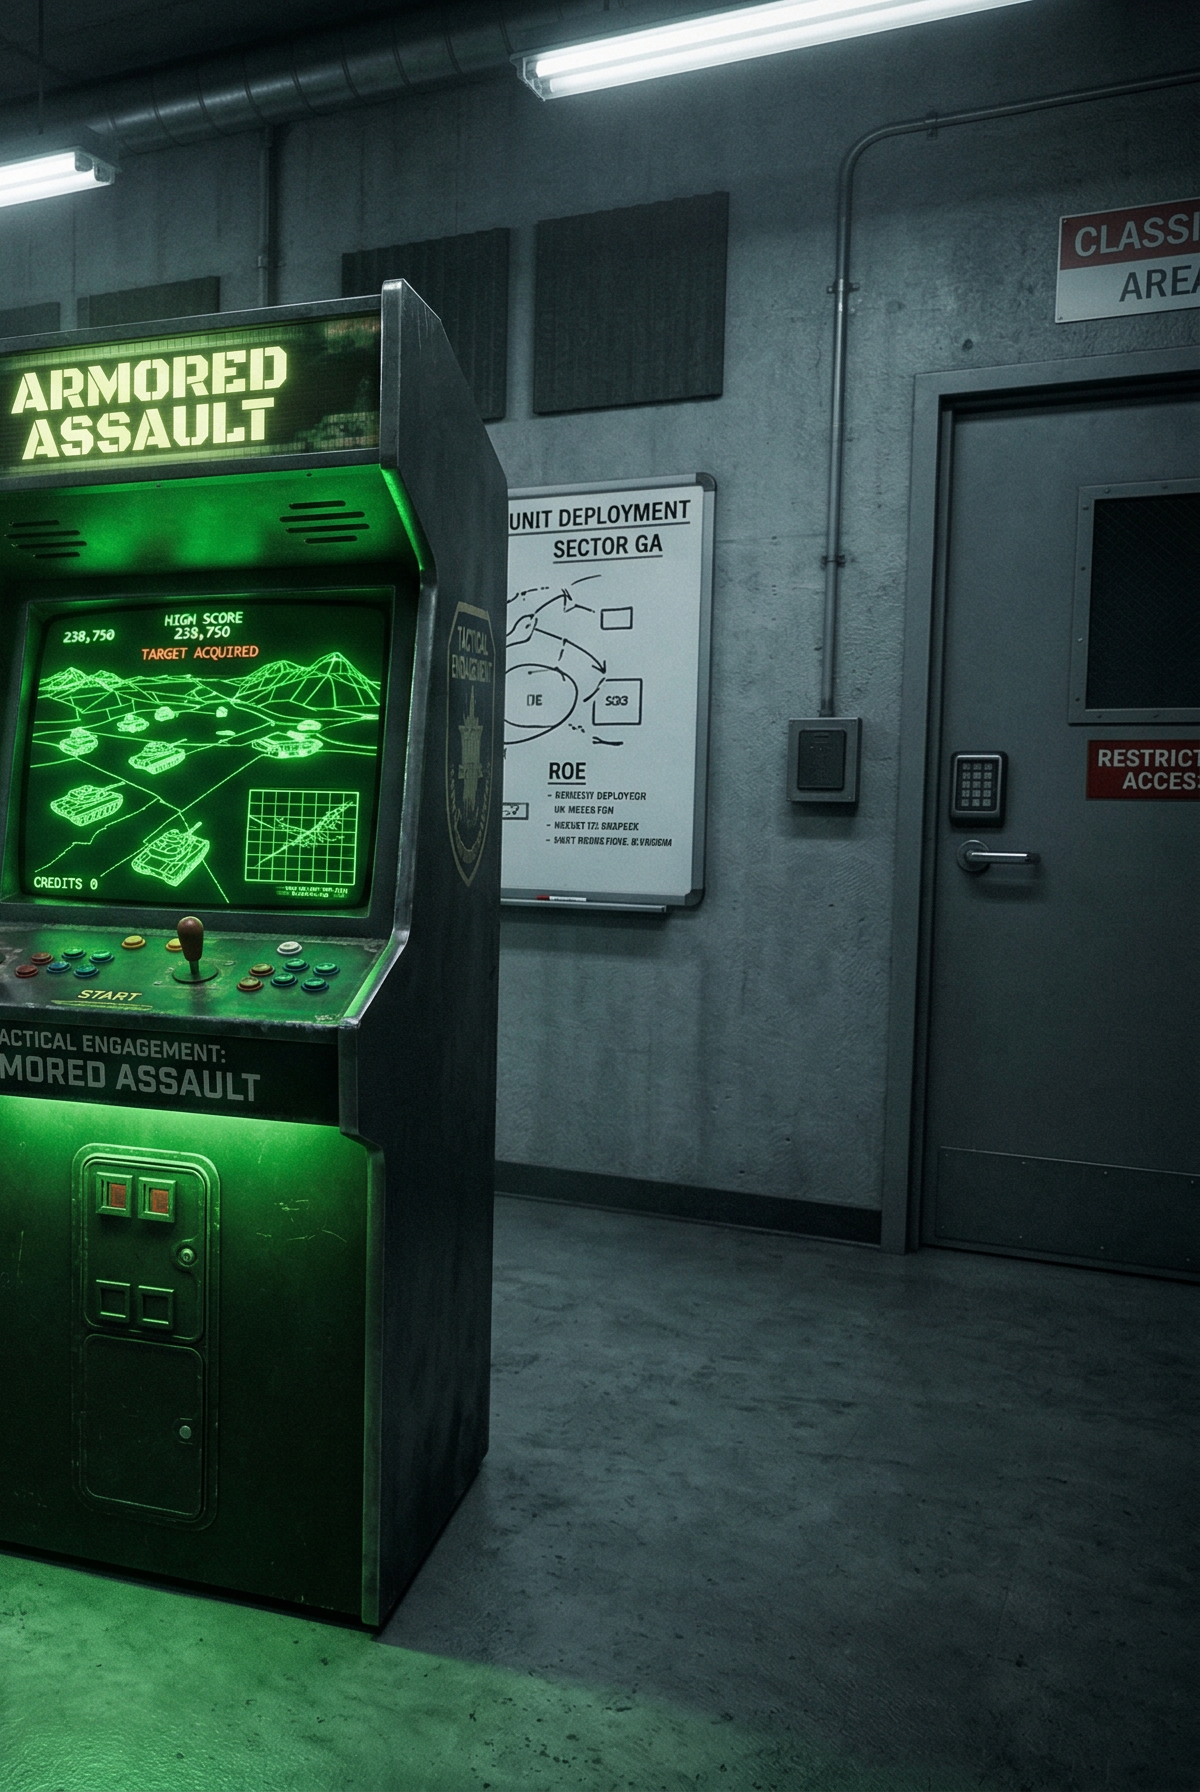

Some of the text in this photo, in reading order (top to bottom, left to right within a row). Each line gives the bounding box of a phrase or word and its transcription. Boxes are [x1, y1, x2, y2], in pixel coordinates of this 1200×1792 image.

[1075, 211, 1200, 257] CLASSI
[11, 346, 287, 414] ARMORED
[22, 398, 275, 460] ASSAULT
[509, 500, 691, 531] UNIT DEPLOYMENT
[553, 533, 663, 558] SECTOR GA
[202, 611, 244, 624] SCORE
[62, 628, 115, 644] 238,750
[174, 625, 231, 641] 238,750
[141, 645, 259, 660] TARGET ACQUIRED
[549, 762, 586, 780] ROE
[1122, 772, 1200, 790] ACCES
[33, 876, 83, 890] CREDITS
[77, 989, 143, 1001] START
[82, 1034, 227, 1063] ENGAGEMENT:
[116, 1063, 261, 1102] ASSAULT
